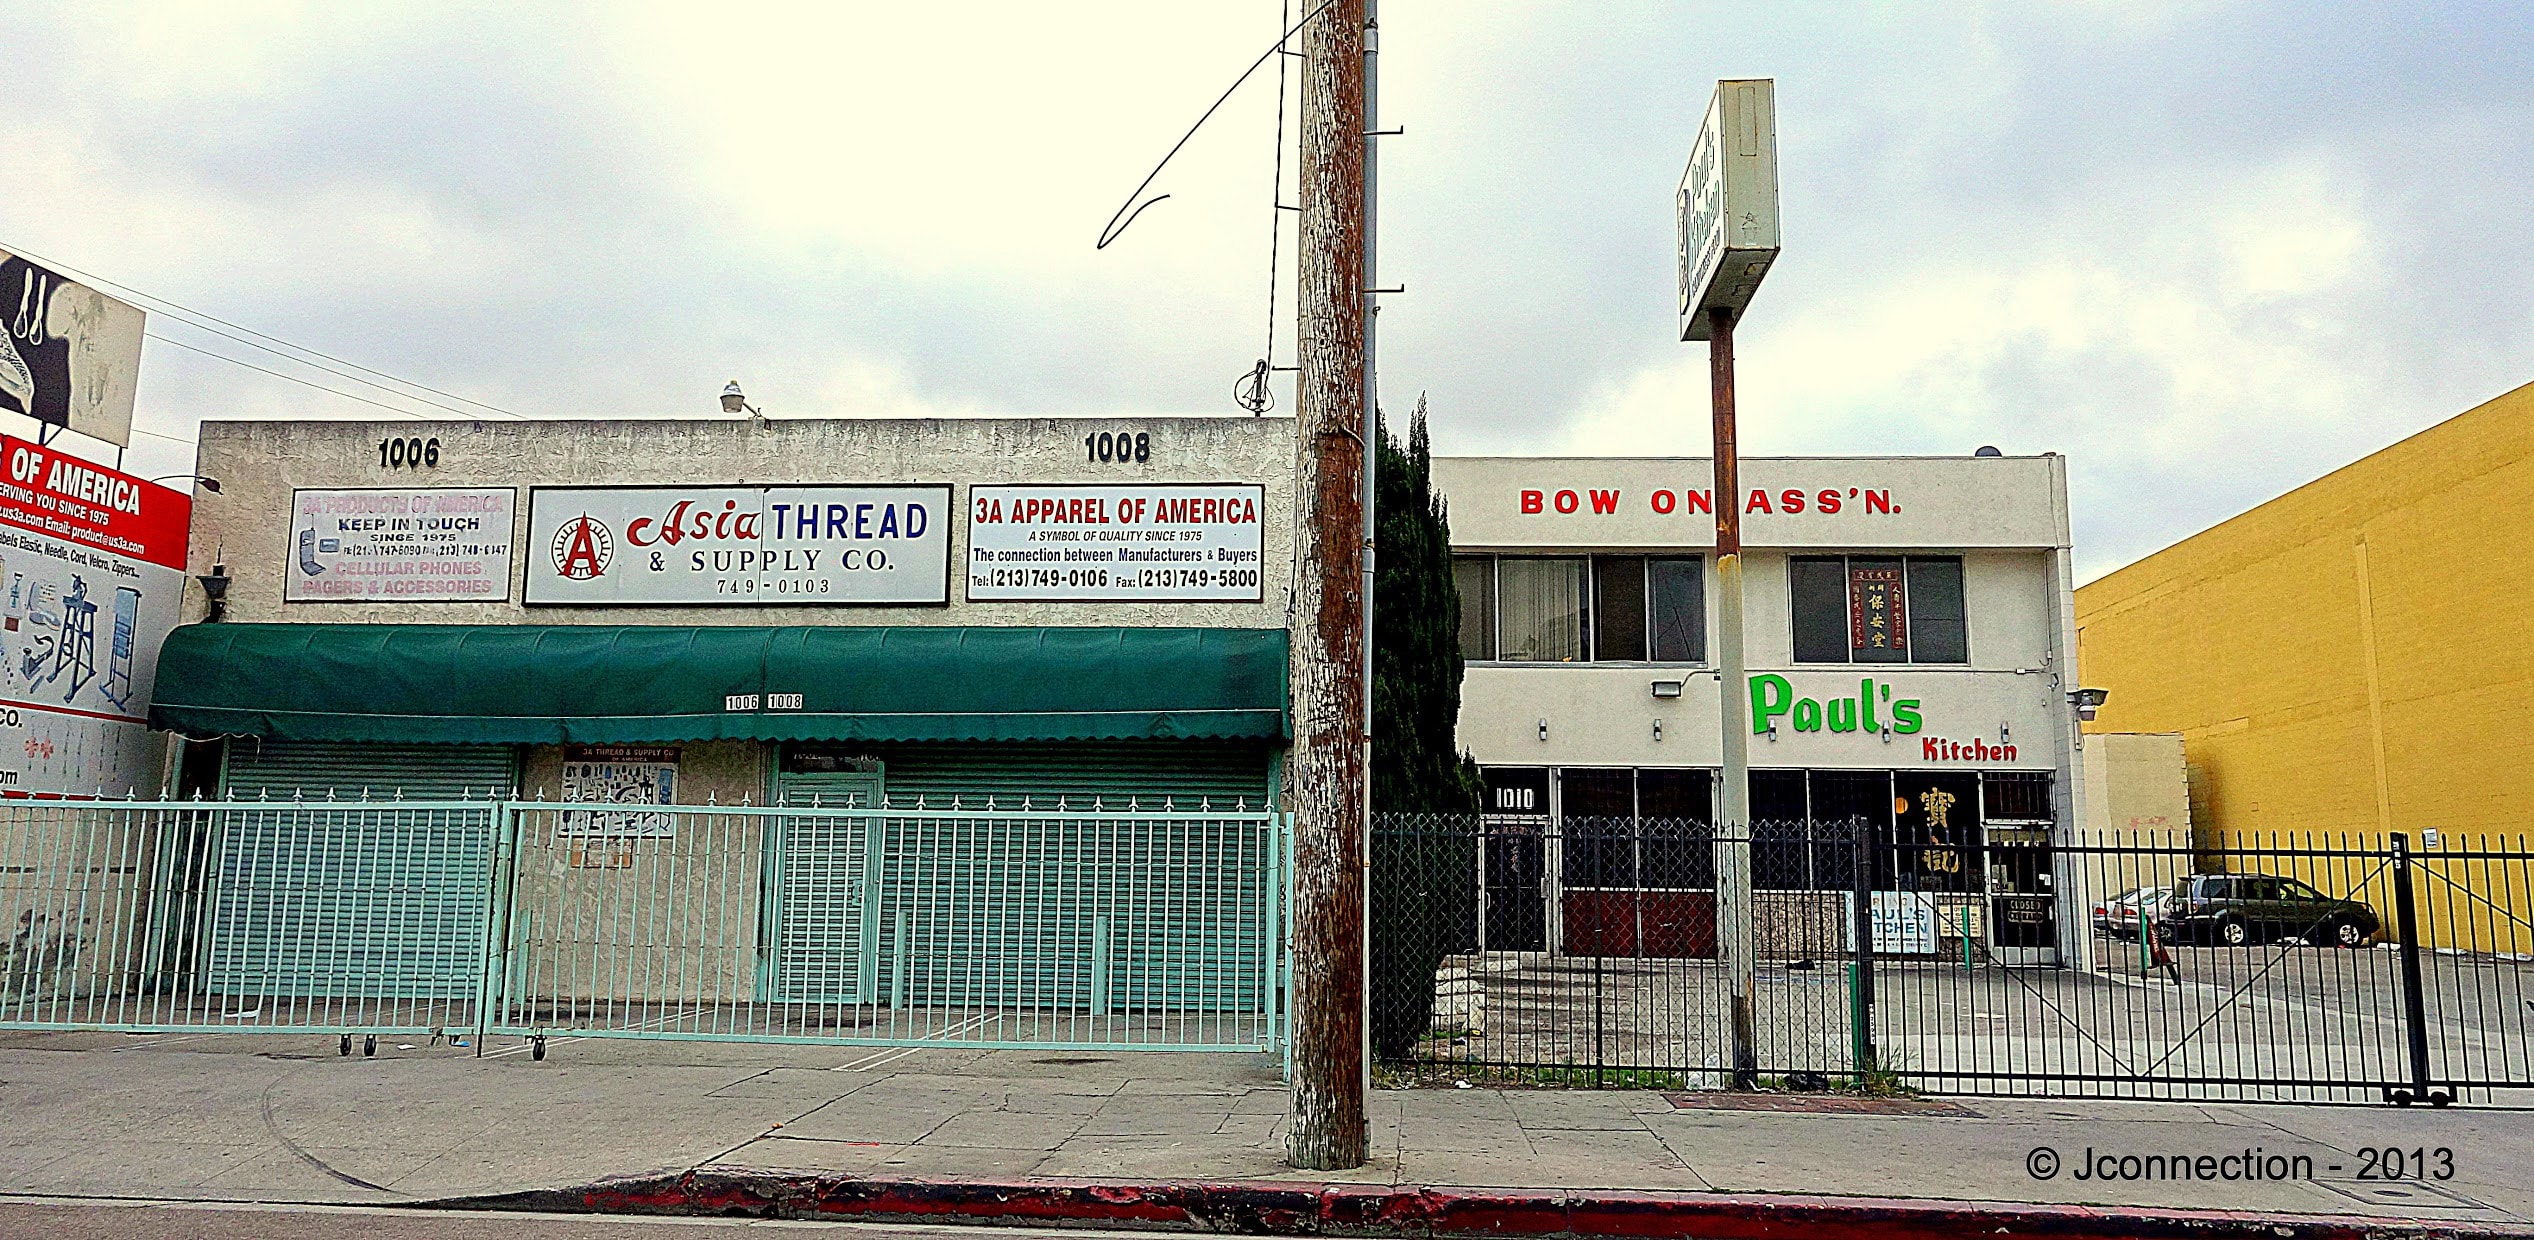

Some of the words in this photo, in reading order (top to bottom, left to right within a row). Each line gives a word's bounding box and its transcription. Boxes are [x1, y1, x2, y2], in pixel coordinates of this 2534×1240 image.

[379, 437, 441, 469] 1006
[1085, 432, 1150, 463] 1008
[12, 448, 43, 484] OF
[46, 460, 140, 515] AMERICA
[36, 493, 56, 510] YOU
[58, 500, 87, 519] SINCE
[89, 510, 110, 526] 1975
[412, 496, 431, 513] OF
[435, 495, 504, 512] AMERICA
[975, 497, 1003, 524] 3A
[1010, 497, 1110, 524] APPAREL
[1118, 497, 1146, 524] OF
[1154, 498, 1257, 524] AMERICA
[1520, 489, 1620, 515] BOW
[1651, 489, 1711, 514] ON
[1746, 489, 1901, 514] ASS'N.
[338, 518, 386, 531] KEEP
[391, 518, 409, 531] IN
[416, 518, 480, 531] TOUCH
[626, 500, 761, 547] Asia
[772, 503, 928, 540] THREAD
[45, 516, 70, 534] Email:
[71, 525, 144, 554] product@us3a.com
[422, 534, 456, 542] 1975
[1028, 531, 1037, 542] A
[1039, 531, 1081, 542] SYMBOL
[1083, 531, 1097, 542] OF
[1099, 531, 1143, 542] QUALITY
[1145, 531, 1177, 542] SINCE
[1179, 531, 1202, 542] 1975
[649, 551, 665, 572] &
[691, 550, 823, 572] SUPPLY
[842, 549, 894, 571] CO.
[974, 548, 994, 562] The
[998, 548, 1061, 562] connection
[1064, 548, 1113, 562] between
[1118, 548, 1202, 562] Manufacturers
[1207, 549, 1214, 561] &
[1218, 548, 1257, 564] Buyers
[335, 562, 415, 576] CELLULAR
[419, 561, 481, 575] PHONES
[302, 580, 363, 595] PAGERS
[367, 580, 379, 595] &
[383, 579, 492, 594] ACCESSORIES
[717, 578, 830, 595] 749-0103
[1116, 576, 1136, 589] Fax:
[1869, 594, 1886, 648] 保安堂
[727, 696, 758, 709] 1006
[770, 695, 801, 708] 1008
[1749, 674, 1923, 734] Paul's
[1922, 737, 2017, 762] Kitchen
[1497, 788, 1534, 809] 1010
[1871, 907, 1925, 920] AUL'S
[1872, 922, 1928, 934] TCHEN
